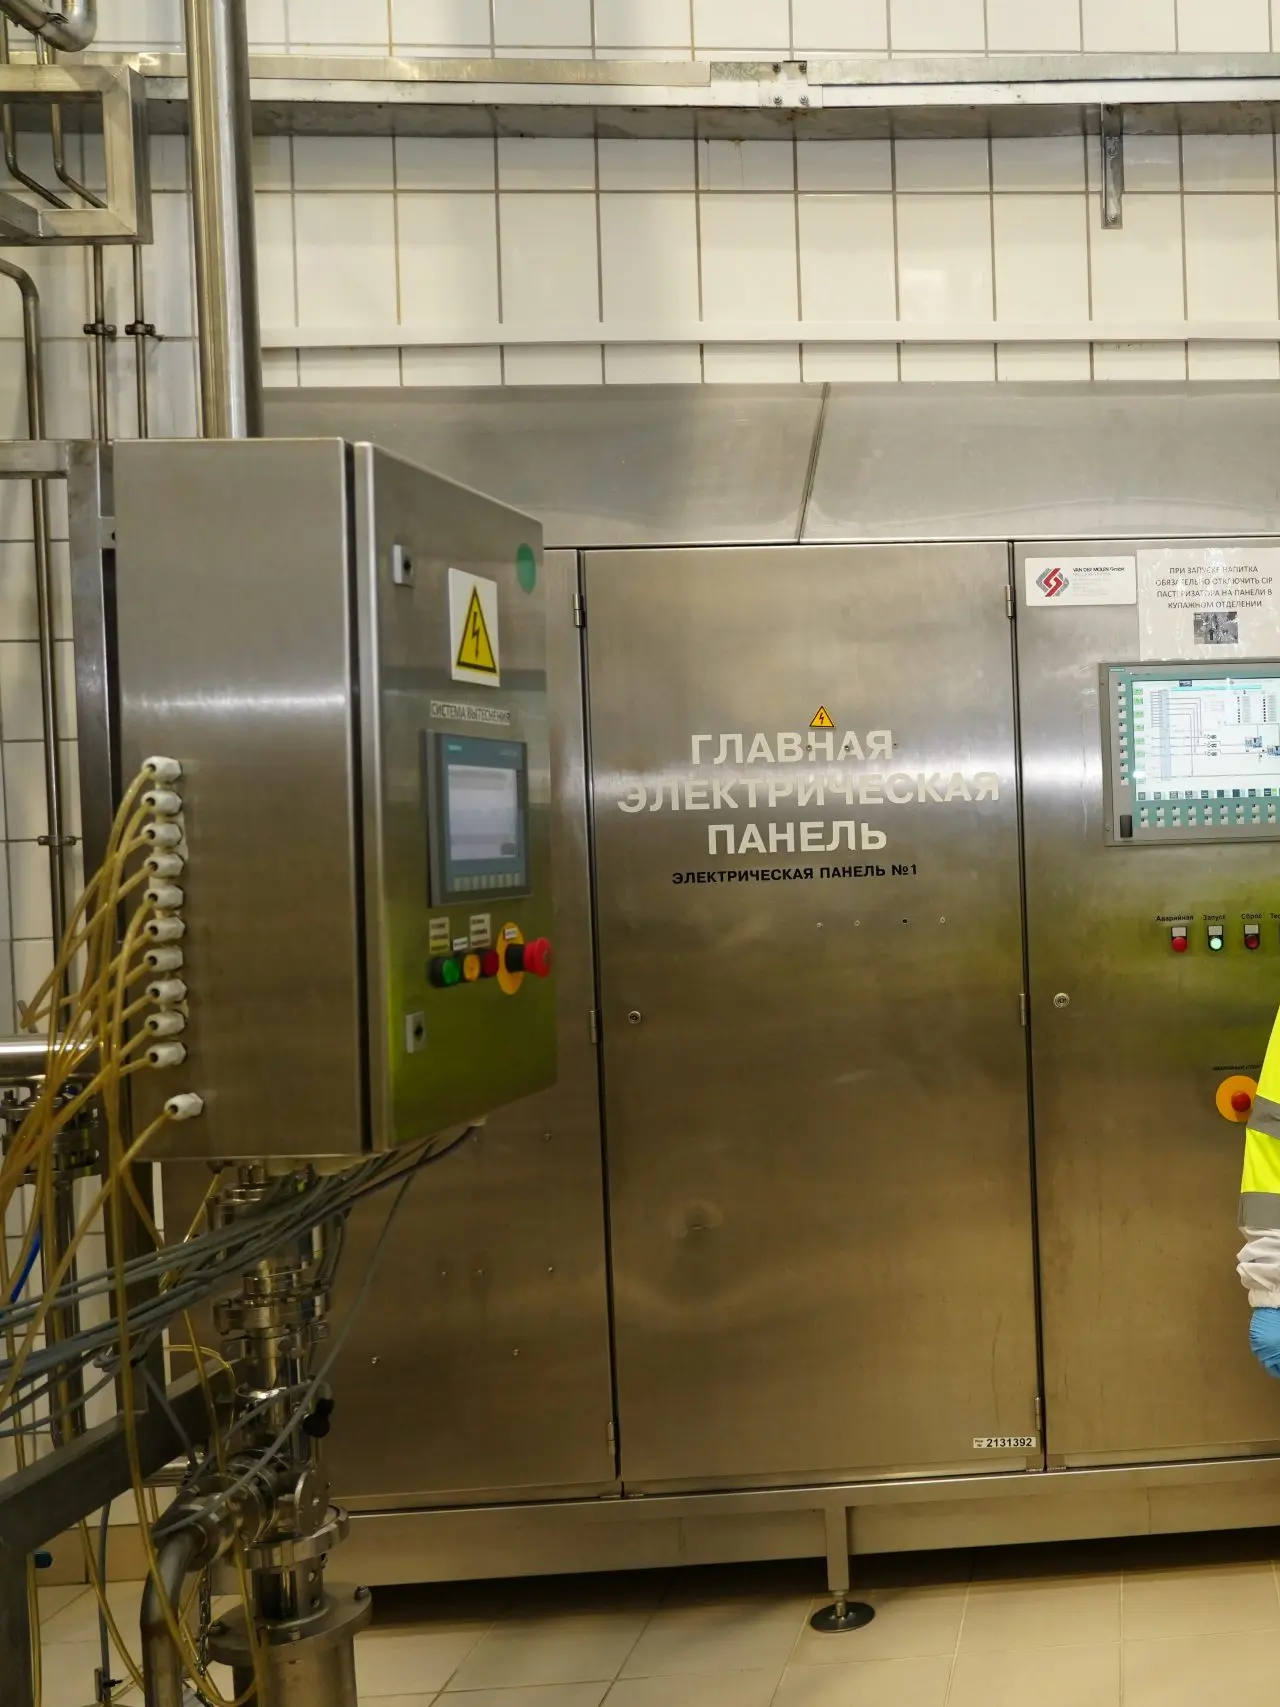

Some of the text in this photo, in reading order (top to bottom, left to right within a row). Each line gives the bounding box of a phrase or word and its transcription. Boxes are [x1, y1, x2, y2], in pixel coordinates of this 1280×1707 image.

[1156, 590, 1220, 598] ПАСТРИЗАТОРА
[1221, 589, 1233, 597] НА
[1234, 588, 1266, 596] ПАНЕЛИ
[1215, 600, 1262, 608] ОТДЕЛЕНИИ
[432, 703, 466, 720] СИСТЕМА
[691, 730, 893, 765] ГЛАВНАЯ
[617, 772, 1000, 813] ЭЛЕКТРИЧЕСКАЯ
[708, 821, 887, 855] ПАНЕЛЬ
[672, 863, 918, 885] ЭЛЕКТРИЧЕСКАЯ ПАНЕЛЬ №1
[1155, 914, 1194, 922] Аварийная
[1241, 912, 1263, 920] Сброс
[986, 1438, 1032, 1447] 2131392
